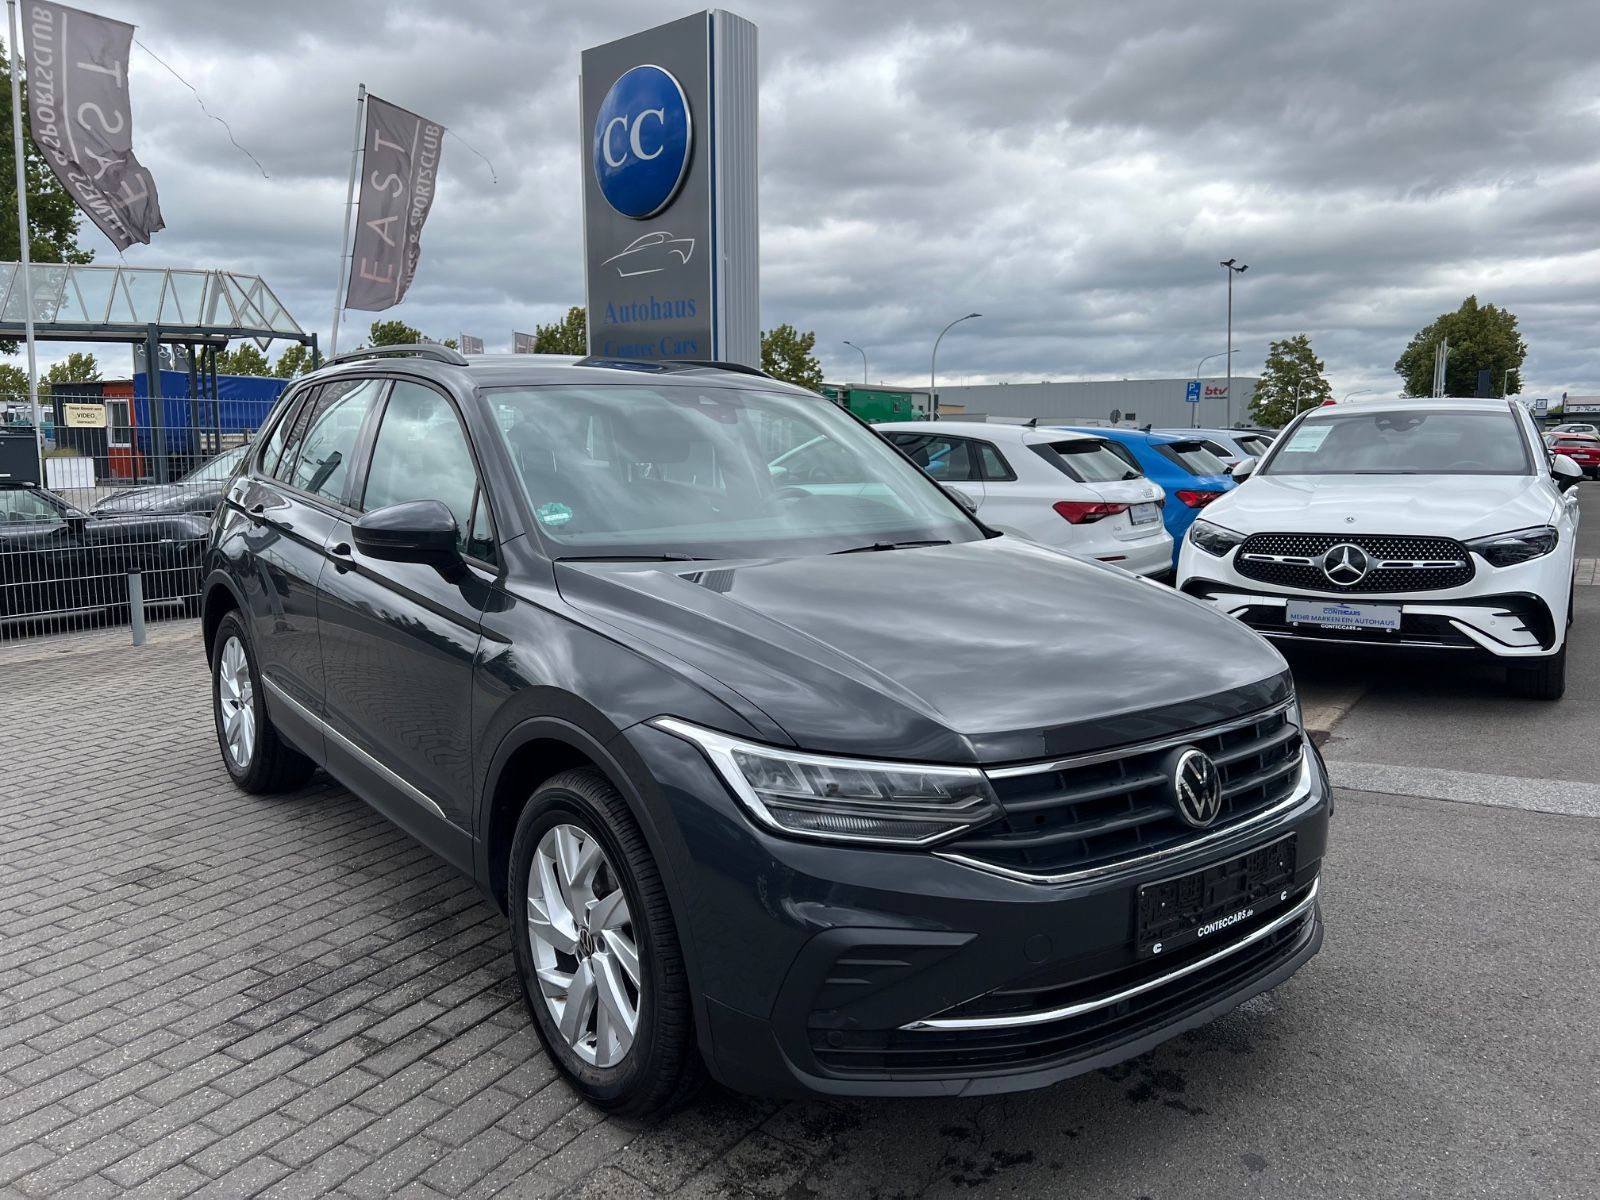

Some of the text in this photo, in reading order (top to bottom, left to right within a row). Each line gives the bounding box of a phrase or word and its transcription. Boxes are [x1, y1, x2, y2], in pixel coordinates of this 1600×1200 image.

[602, 107, 665, 168] CC
[410, 124, 440, 227] SPORTSCLUB
[359, 129, 405, 283] EAST
[604, 296, 697, 325] Autohaus
[1205, 386, 1228, 395] btv
[1354, 618, 1395, 626] AUTOHAUS
[1197, 909, 1254, 938] CONTECCARS.de
